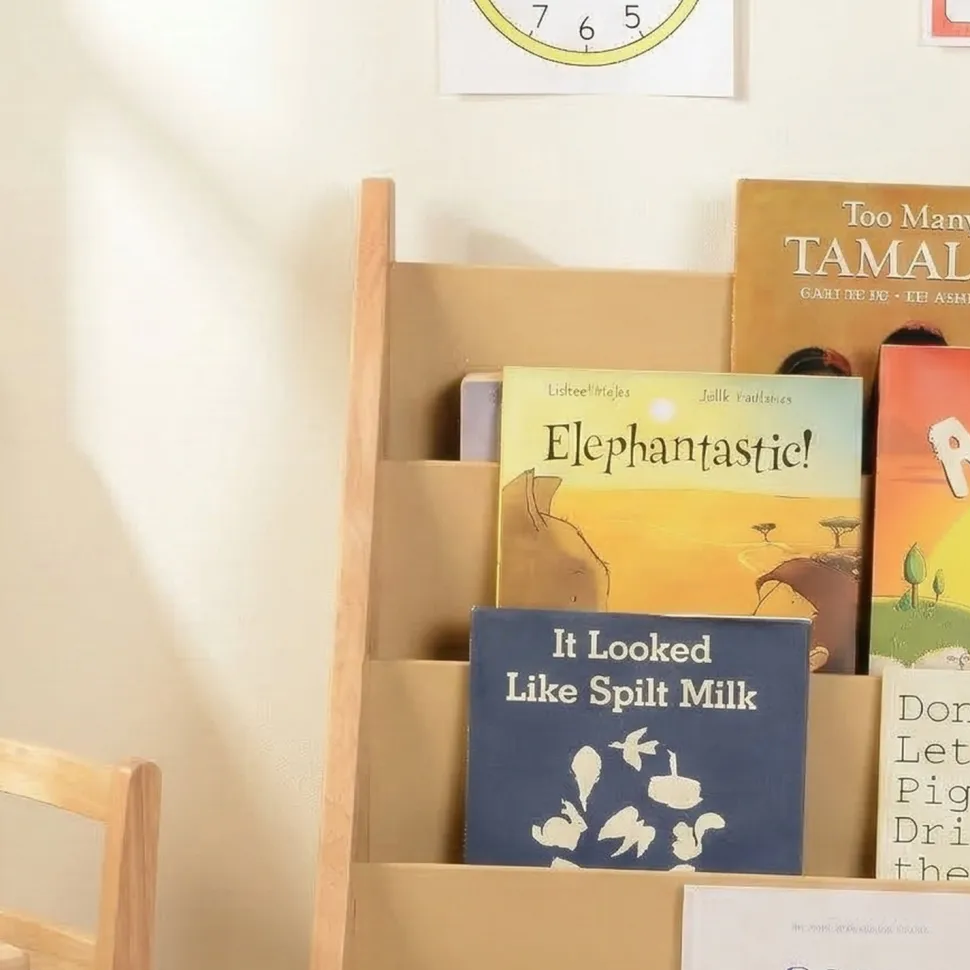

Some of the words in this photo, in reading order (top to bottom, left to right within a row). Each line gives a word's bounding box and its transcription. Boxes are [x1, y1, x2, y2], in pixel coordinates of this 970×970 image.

[532, 5, 549, 28] 7
[579, 16, 595, 40] 6
[625, 5, 641, 28] 5
[842, 200, 893, 229] Too
[543, 420, 813, 475] Elephantastic!
[552, 628, 576, 659] It
[587, 630, 713, 664] Looked
[505, 671, 578, 704] Like
[589, 675, 669, 714] Spilt
[679, 678, 758, 711] Milk
[895, 735, 970, 766] Let
